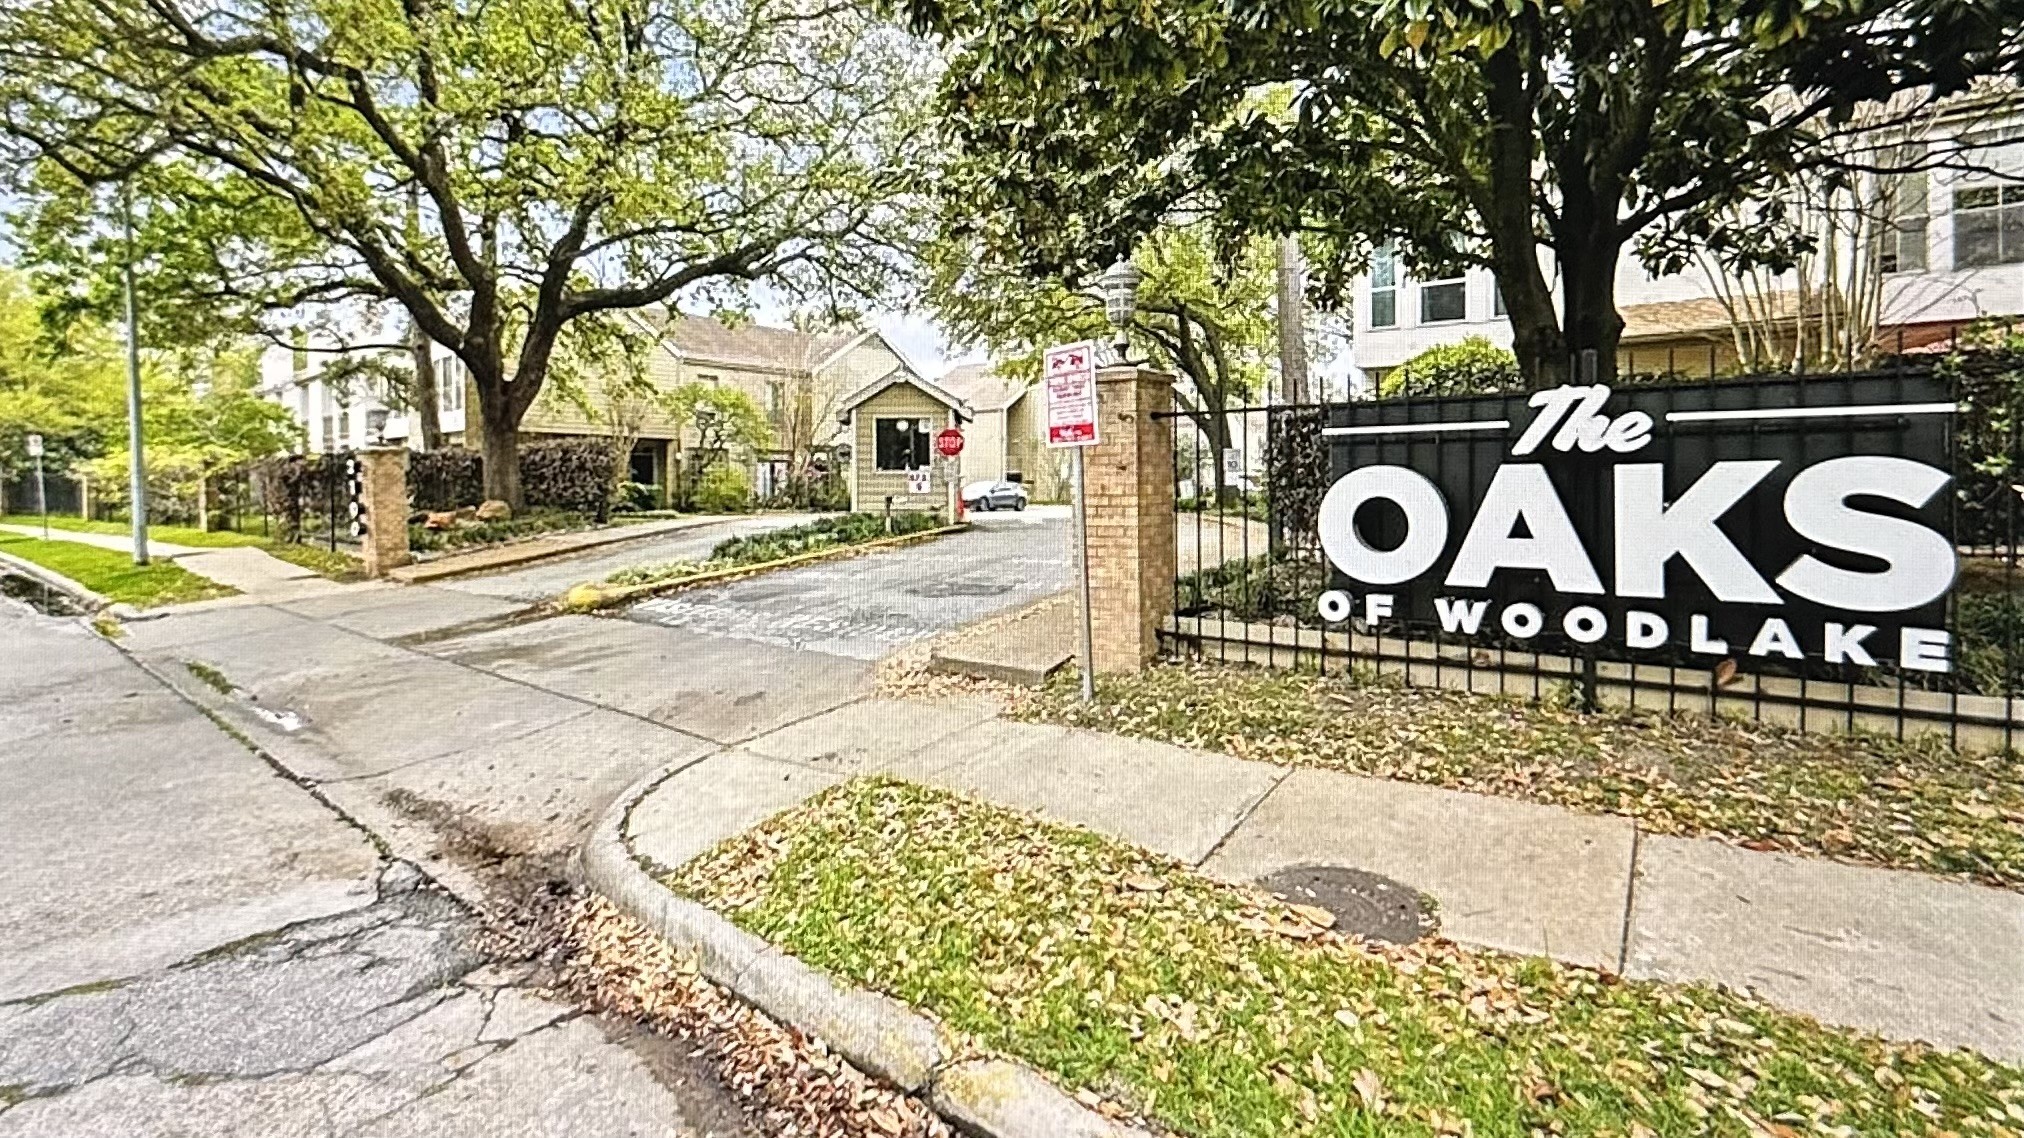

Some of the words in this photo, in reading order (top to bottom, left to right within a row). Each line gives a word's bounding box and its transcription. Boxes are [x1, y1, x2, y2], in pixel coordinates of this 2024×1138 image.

[938, 436, 963, 448] STOP
[1511, 384, 1653, 455] The
[1318, 456, 1957, 612] OAKS
[1318, 590, 1393, 625] OF
[1434, 598, 1951, 672] WOODLAKE
